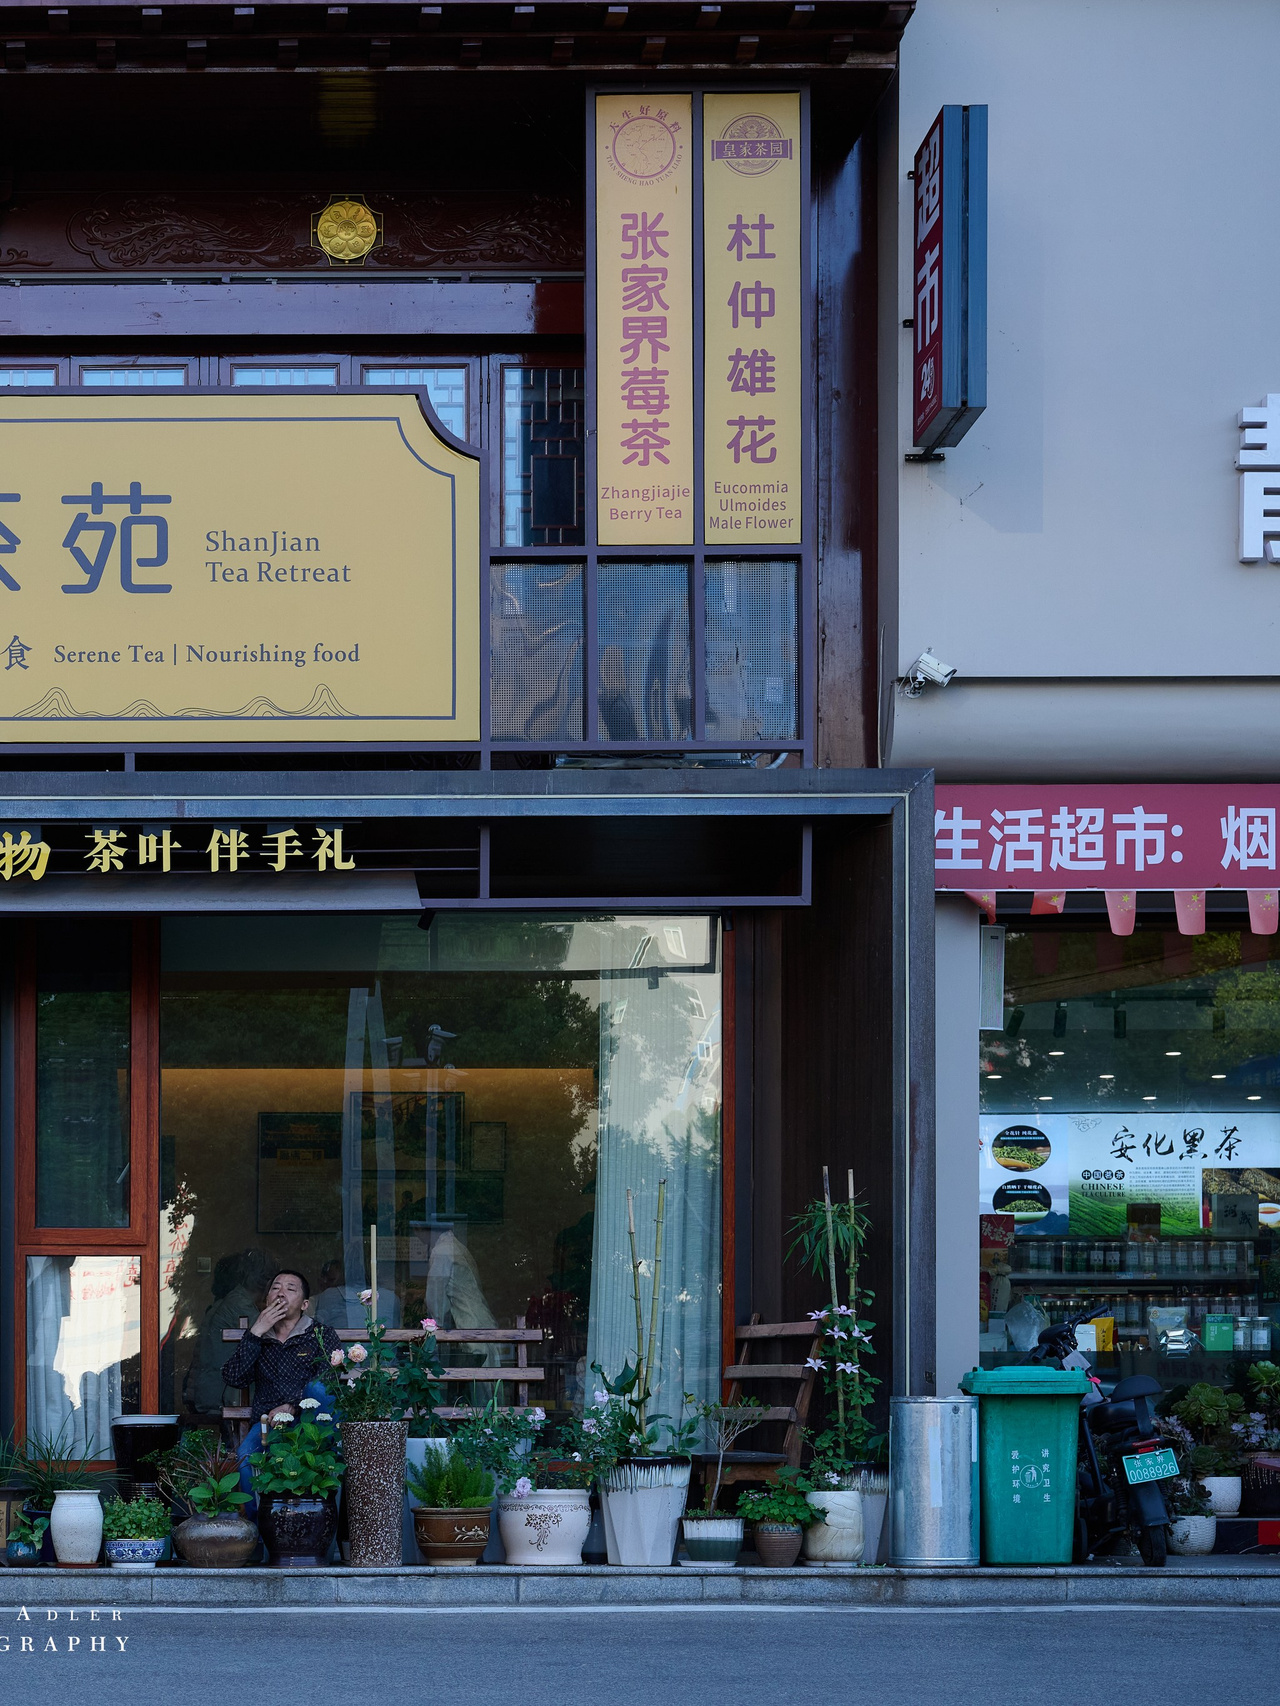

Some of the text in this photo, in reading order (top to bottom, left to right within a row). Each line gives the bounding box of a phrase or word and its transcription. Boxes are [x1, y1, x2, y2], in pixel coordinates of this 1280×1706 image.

[609, 105, 682, 134] 天生好原料
[723, 142, 783, 158] 皇家茶园
[606, 154, 617, 170] TIAN
[616, 170, 637, 186] SHENG
[656, 169, 674, 184] YUAN
[672, 154, 683, 170] LIAO
[918, 123, 940, 354] 超市
[620, 211, 671, 467] 张家界莓茶
[726, 213, 777, 464] 杜仲雄花
[601, 485, 690, 501] Zhangjiajie
[714, 480, 789, 494] Eucommia
[610, 507, 682, 523] Berry Tea
[720, 499, 787, 512] Ulmoides
[709, 516, 794, 529] Male Flower
[206, 531, 321, 557] ShanJian
[206, 562, 351, 583] Tea Retreat
[54, 644, 121, 664] Serene
[128, 644, 165, 664] Tea
[186, 644, 307, 668] Nourishing
[314, 643, 360, 663] food
[1221, 805, 1276, 871] 烟
[84, 829, 182, 874] 茶叶
[206, 829, 356, 873] 伴手礼
[1110, 1125, 1243, 1163] 安化黑茶
[1130, 1462, 1176, 1482] 0088926
[1134, 1455, 1164, 1468] 张家界
[1011, 1450, 1021, 1504] 爱护环境
[1041, 1449, 1051, 1503] 讲究卫生
